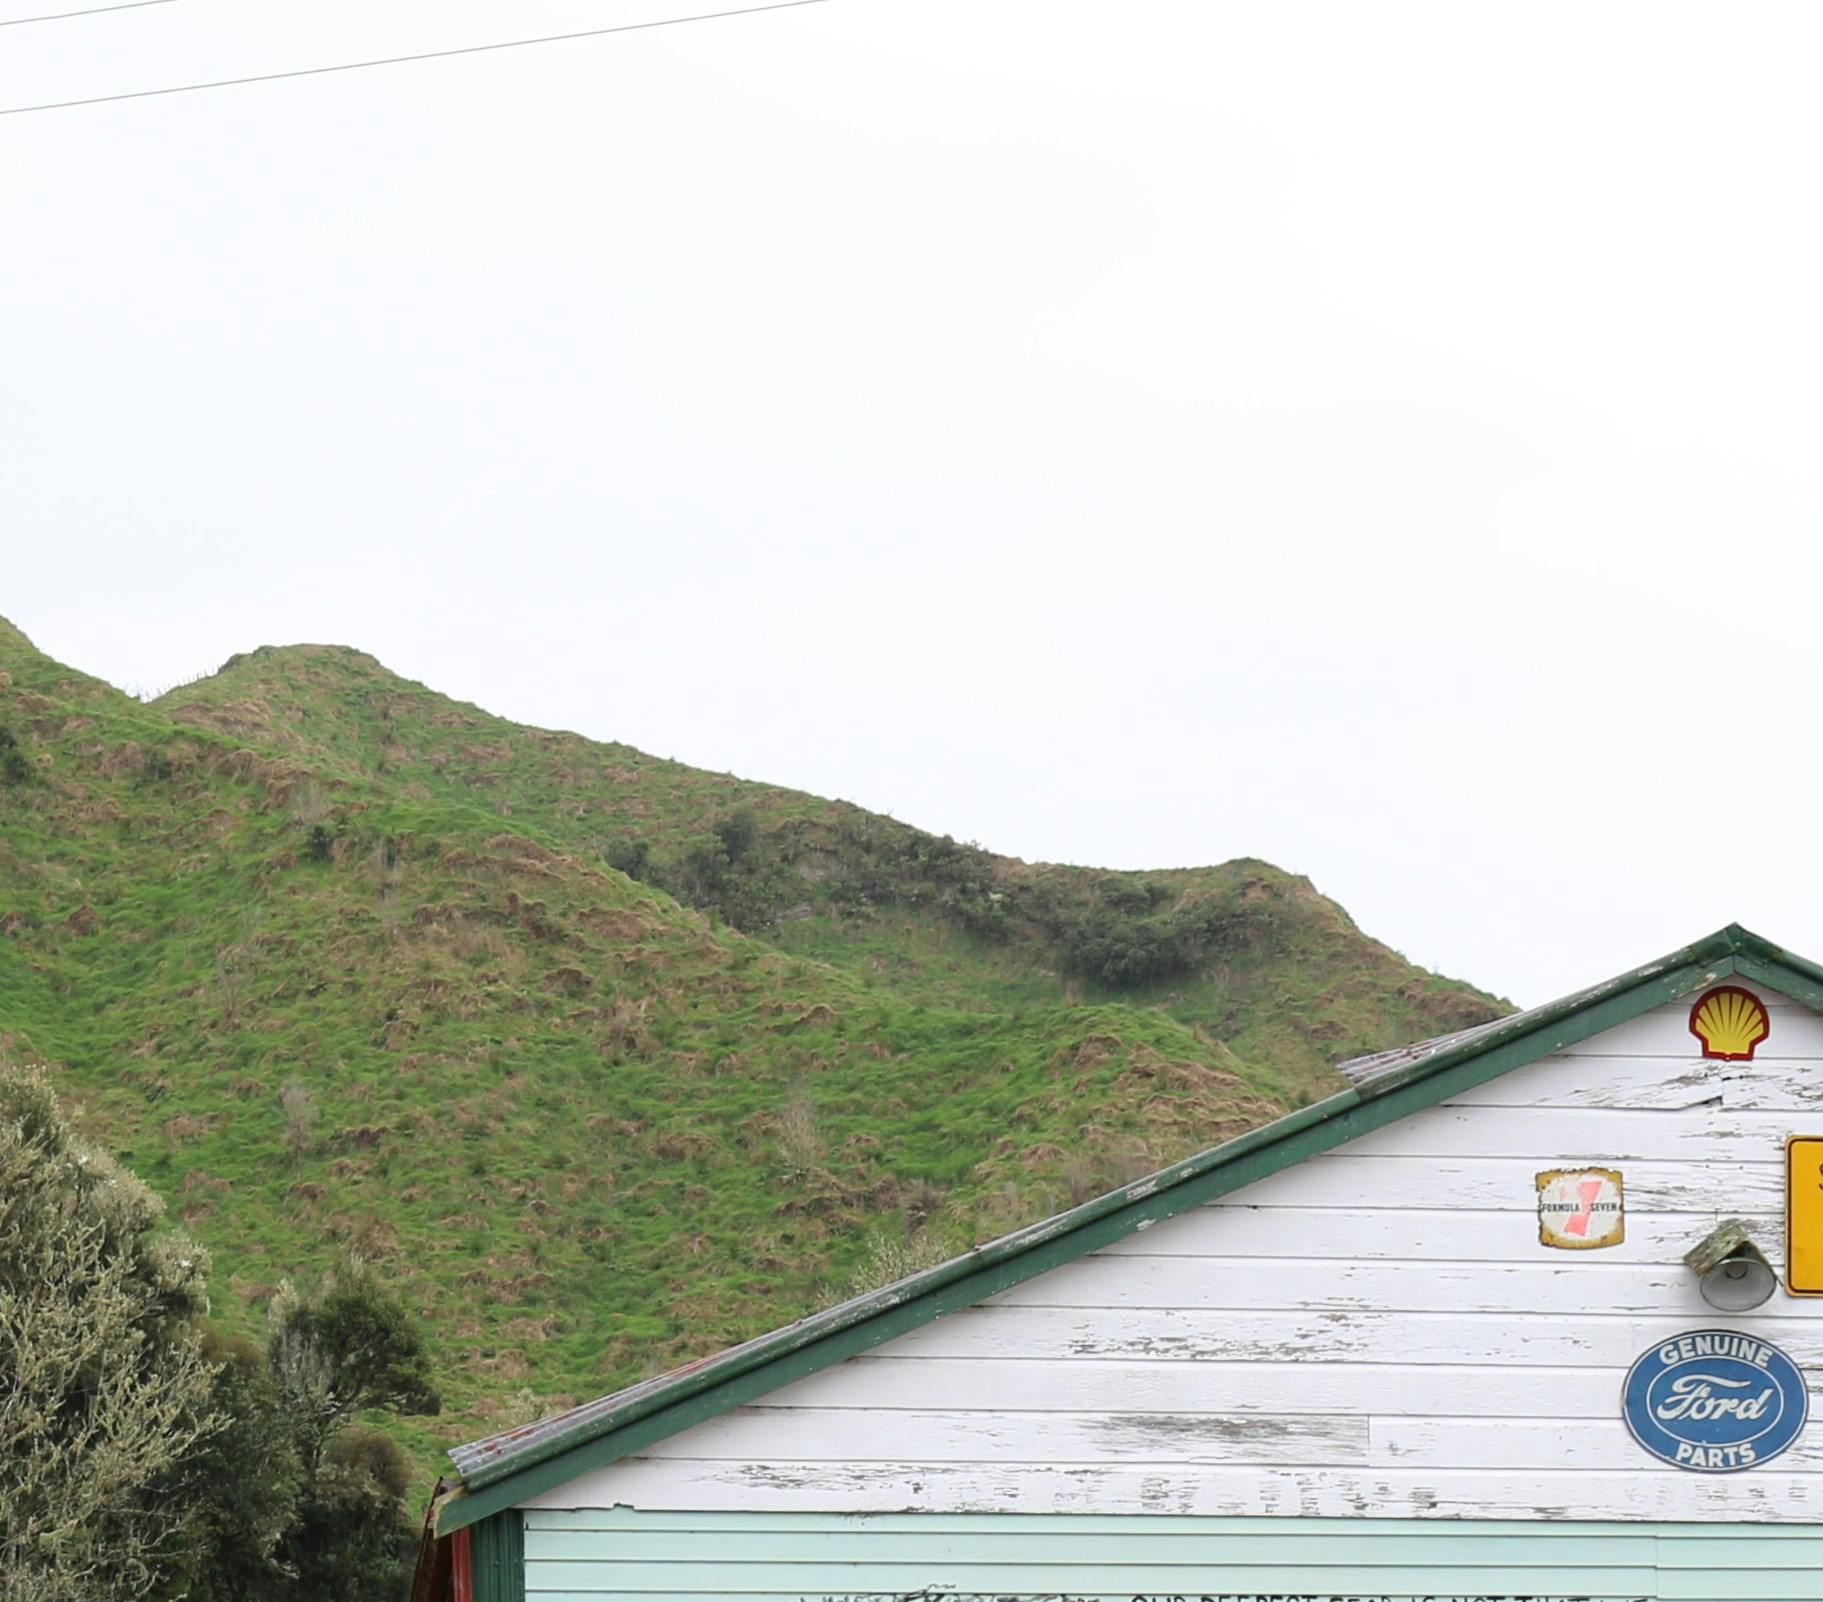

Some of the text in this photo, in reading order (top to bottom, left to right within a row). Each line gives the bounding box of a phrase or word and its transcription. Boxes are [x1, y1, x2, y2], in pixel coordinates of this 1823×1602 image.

[1542, 1202, 1618, 1213] FORMULA SEVEN
[1659, 1335, 1774, 1368] GENUINE
[1657, 1374, 1774, 1420] Ford
[1675, 1442, 1756, 1468] PARTS
